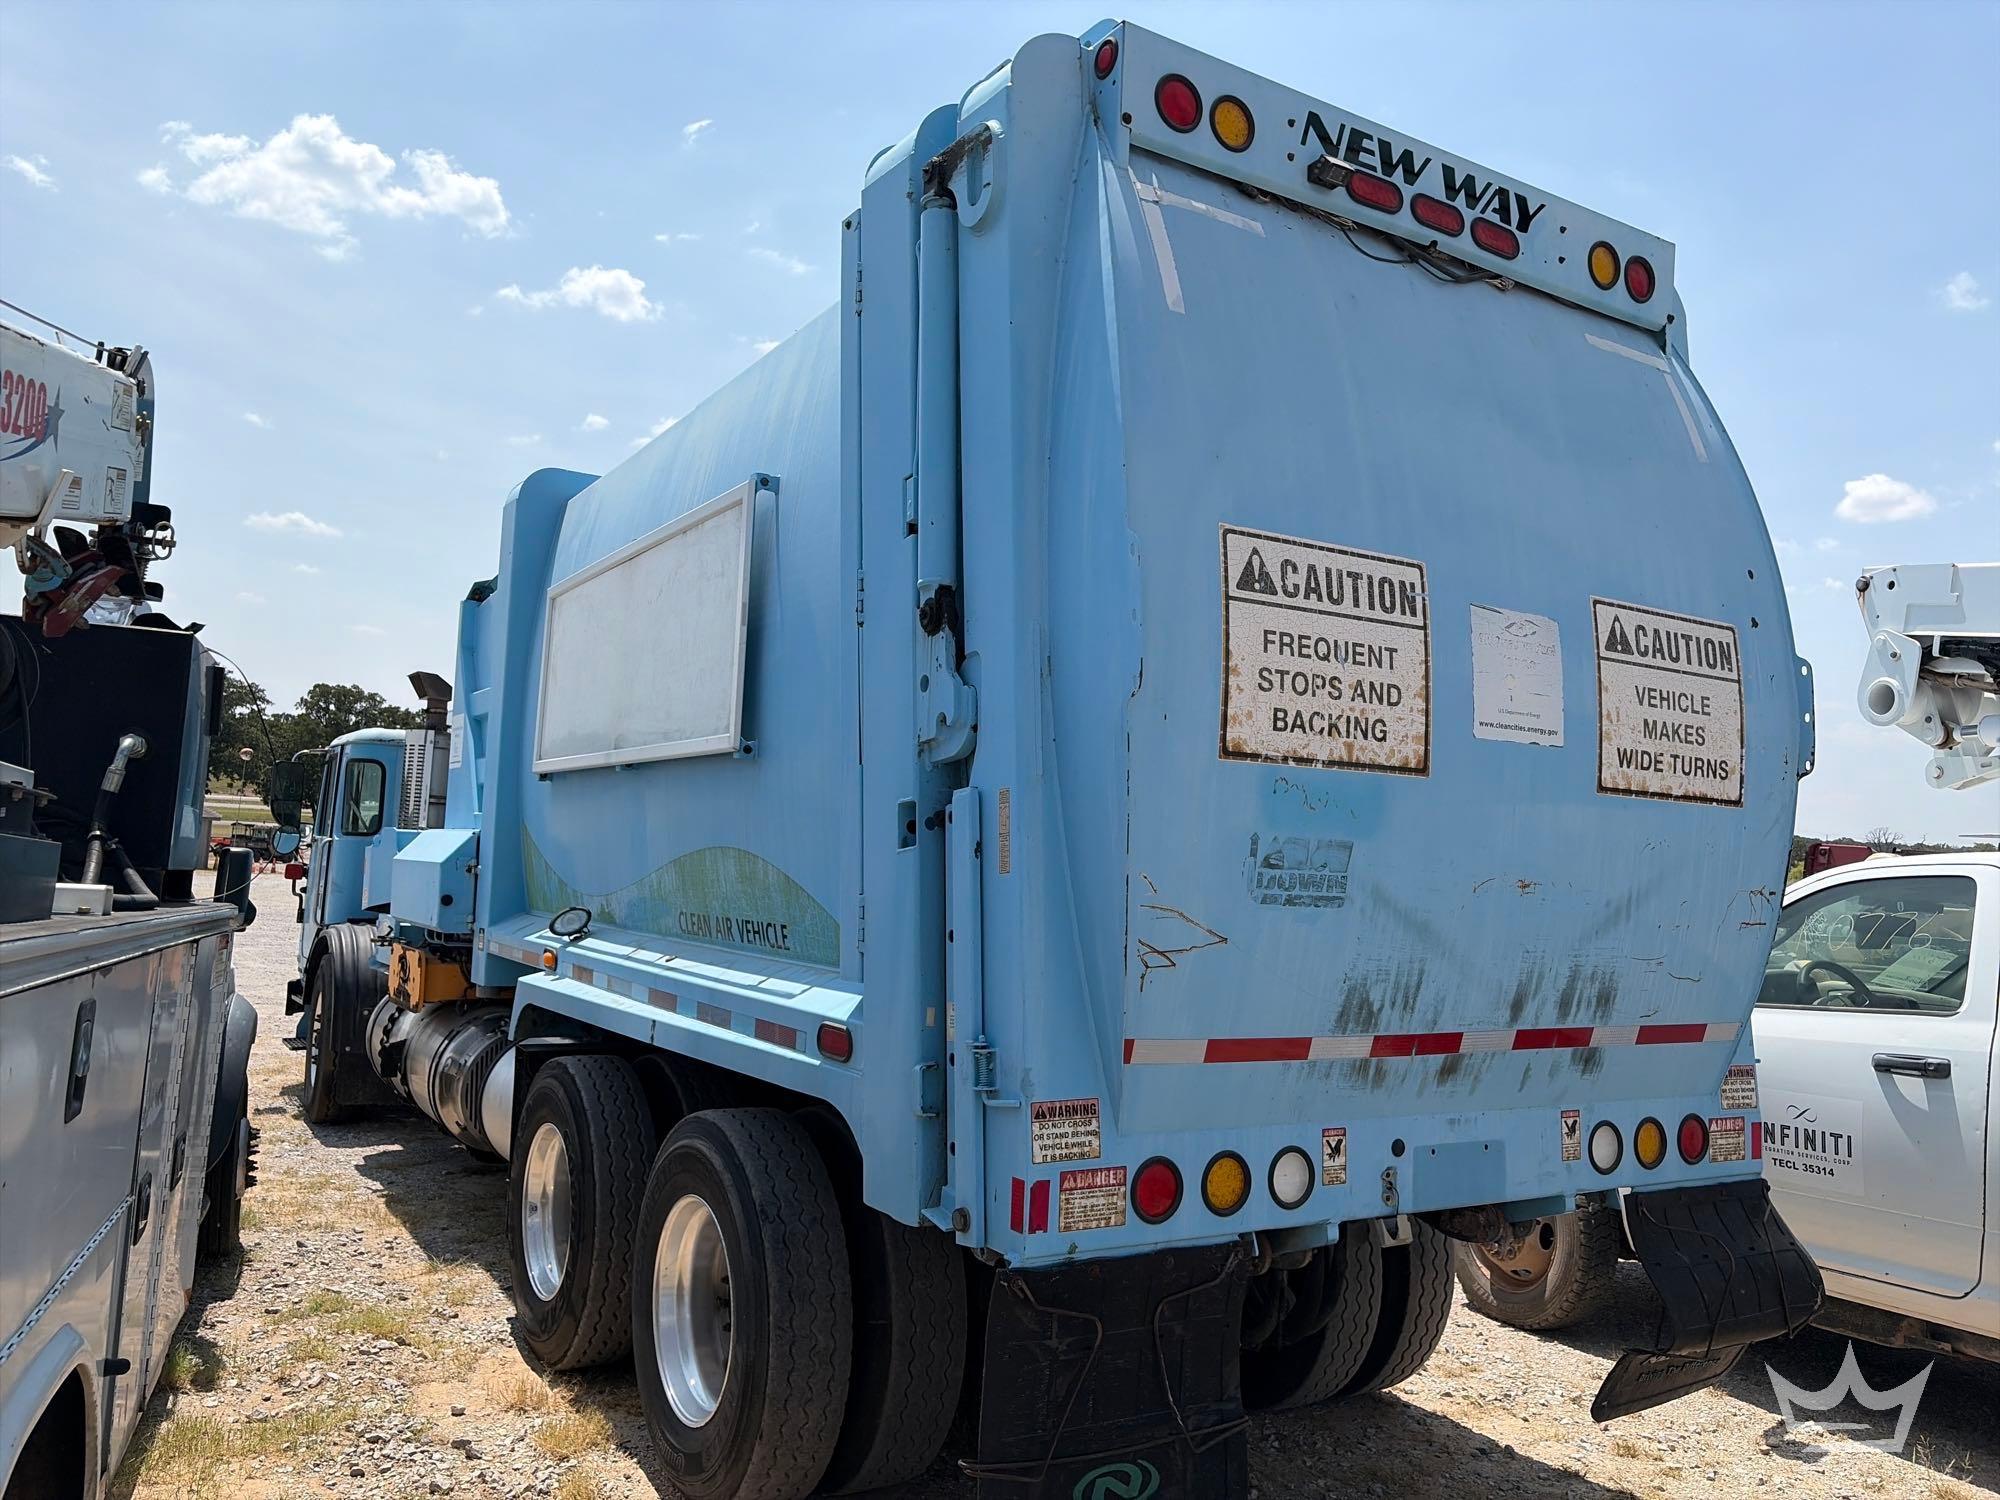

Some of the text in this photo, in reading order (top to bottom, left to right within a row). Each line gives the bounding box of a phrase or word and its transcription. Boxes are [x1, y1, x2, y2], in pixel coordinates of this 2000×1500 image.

[1300, 110, 1546, 233] NEW WAY
[0, 369, 47, 441] 3200
[1280, 558, 1418, 618] CAUTION
[1263, 629, 1398, 670] FREQUENT
[1634, 624, 1734, 673] CAUTION
[1258, 667, 1402, 707] STOPS AND
[1634, 685, 1711, 716] VEHICLE
[1272, 707, 1387, 743] BACKING
[1479, 720, 1559, 736] www.cleancities.energy.gov
[1643, 718, 1706, 747] MAKES
[1616, 747, 1729, 780] WIDE TURNS
[679, 911, 790, 951] CLEAN AIR VEHICLE
[1047, 1103, 1097, 1118] WARNING
[1051, 1121, 1066, 1130] NOT
[1067, 1120, 1092, 1128] CROSS
[1039, 1140, 1092, 1151] VEHICLE WHILE
[1046, 1131, 1069, 1140] STAND
[1071, 1129, 1097, 1138] BEHIND
[1763, 1121, 1853, 1158] NFINITI
[1042, 1151, 1091, 1162] IT IS BACKING
[1772, 1158, 1835, 1177] TECL 35314
[1076, 1169, 1124, 1188] DANGER
